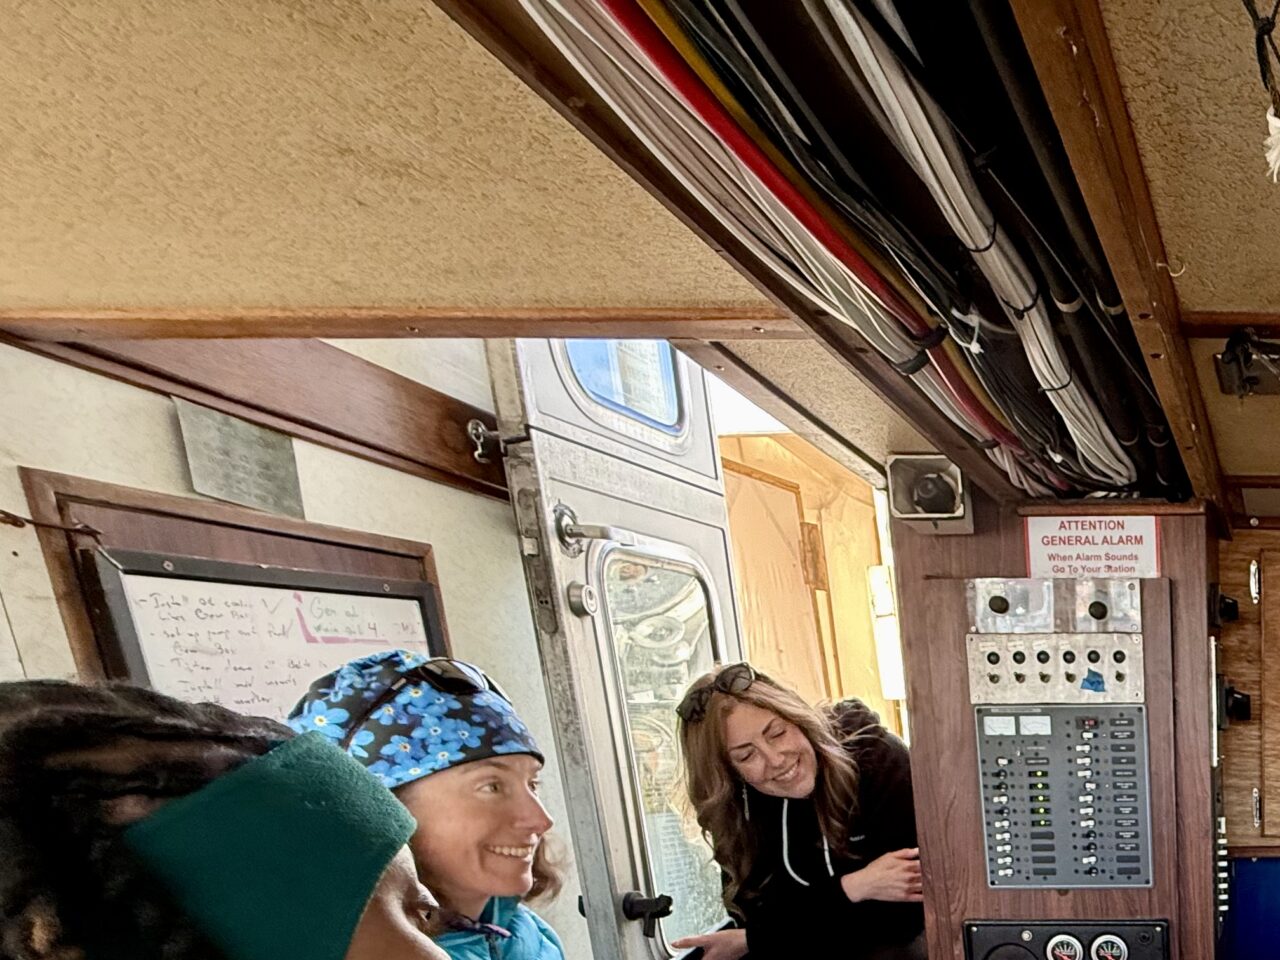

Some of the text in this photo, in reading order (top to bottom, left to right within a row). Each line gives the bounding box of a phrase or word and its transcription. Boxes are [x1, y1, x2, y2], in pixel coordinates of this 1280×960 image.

[1058, 520, 1125, 531] ATTENTION
[1041, 535, 1144, 546] GENERAL ALARM
[1047, 552, 1138, 562] When Alarm Sounds
[1052, 565, 1135, 573] Go To Your Station
